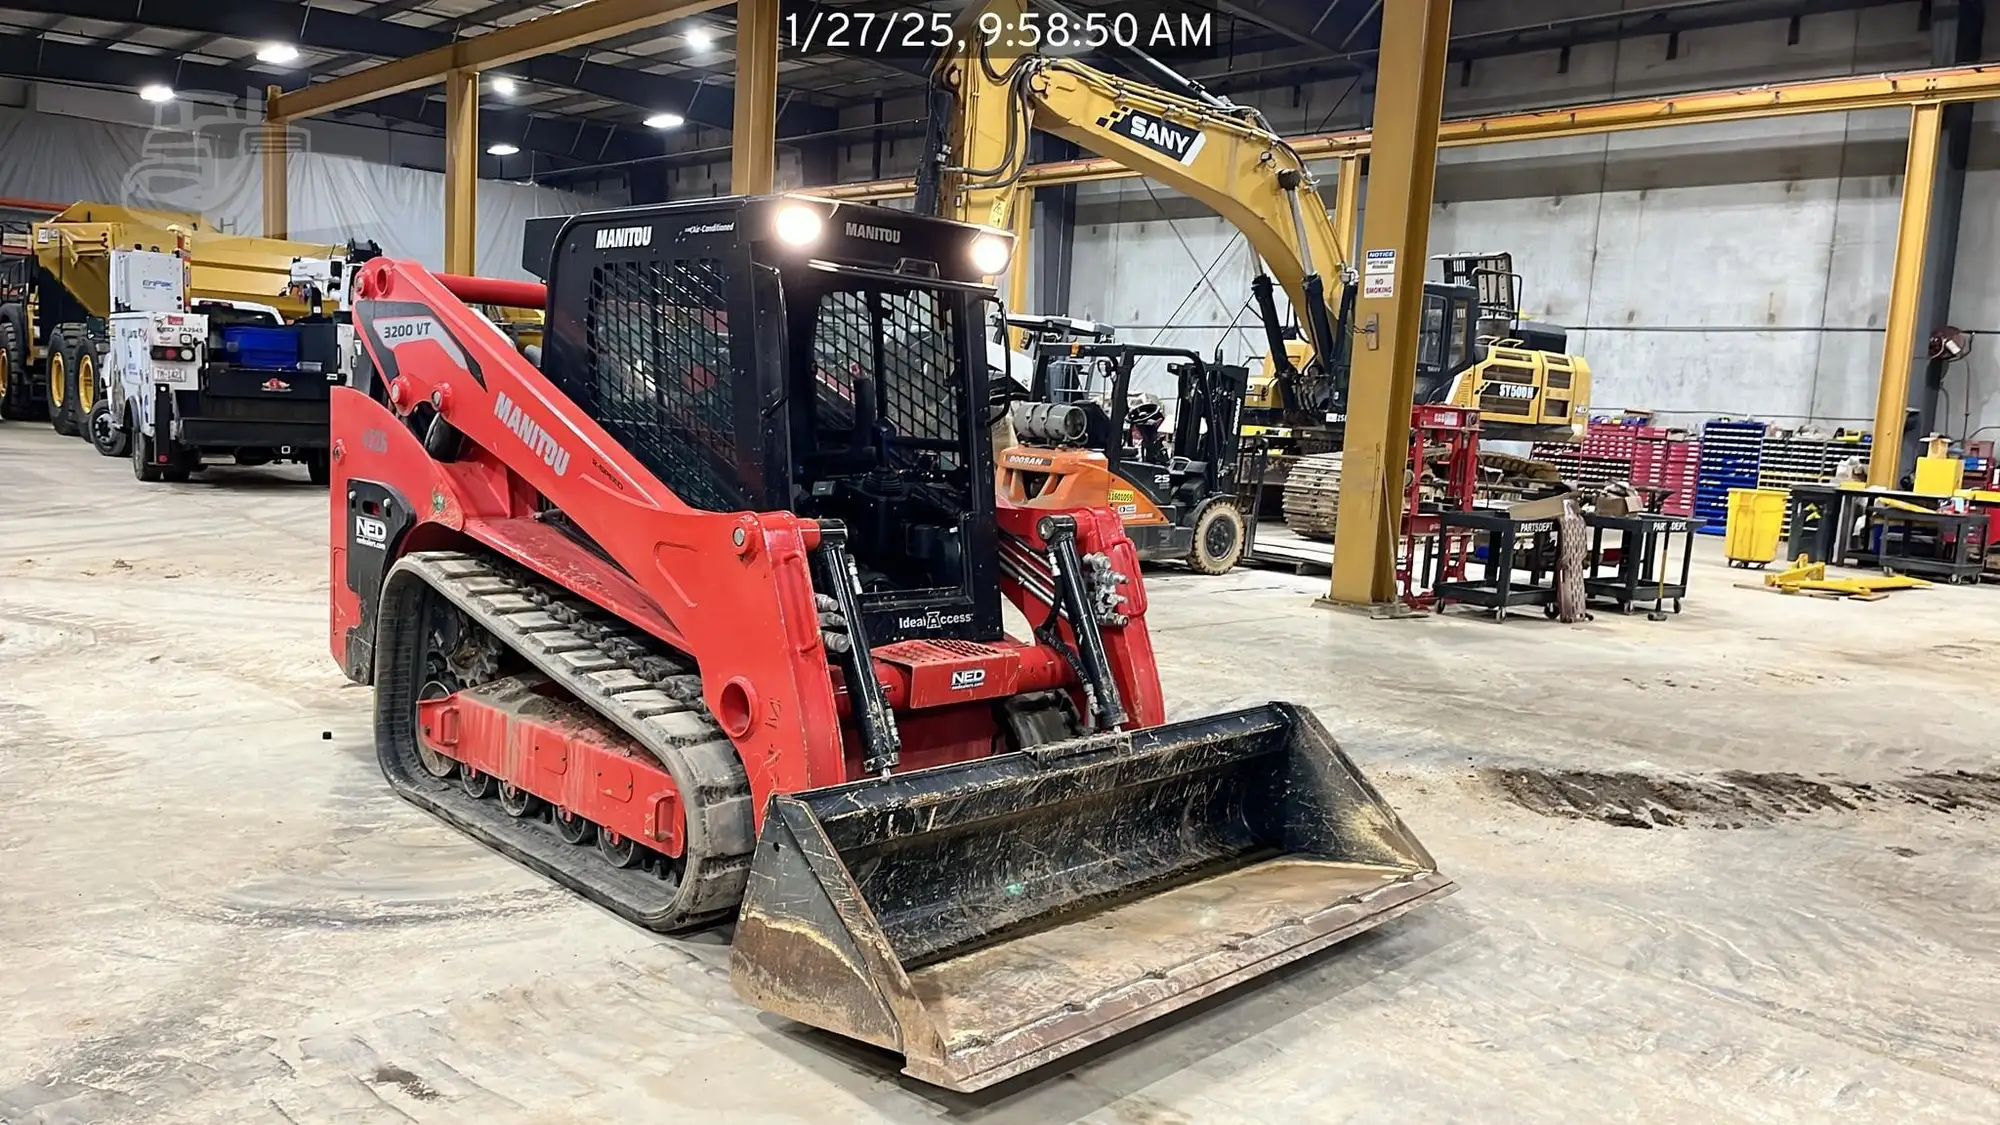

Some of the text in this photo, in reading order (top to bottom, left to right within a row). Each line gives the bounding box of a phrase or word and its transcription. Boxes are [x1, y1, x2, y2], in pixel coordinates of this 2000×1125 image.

[1130, 115, 1191, 155] SANY
[595, 225, 653, 249] MANITOU
[845, 221, 901, 244] MANITOU
[384, 322, 431, 338] 3200 VT
[1499, 384, 1534, 399] SY500H
[493, 390, 571, 477] MANITOU
[1154, 474, 1171, 483] 25
[356, 516, 387, 542] NED
[951, 669, 985, 686] NED
